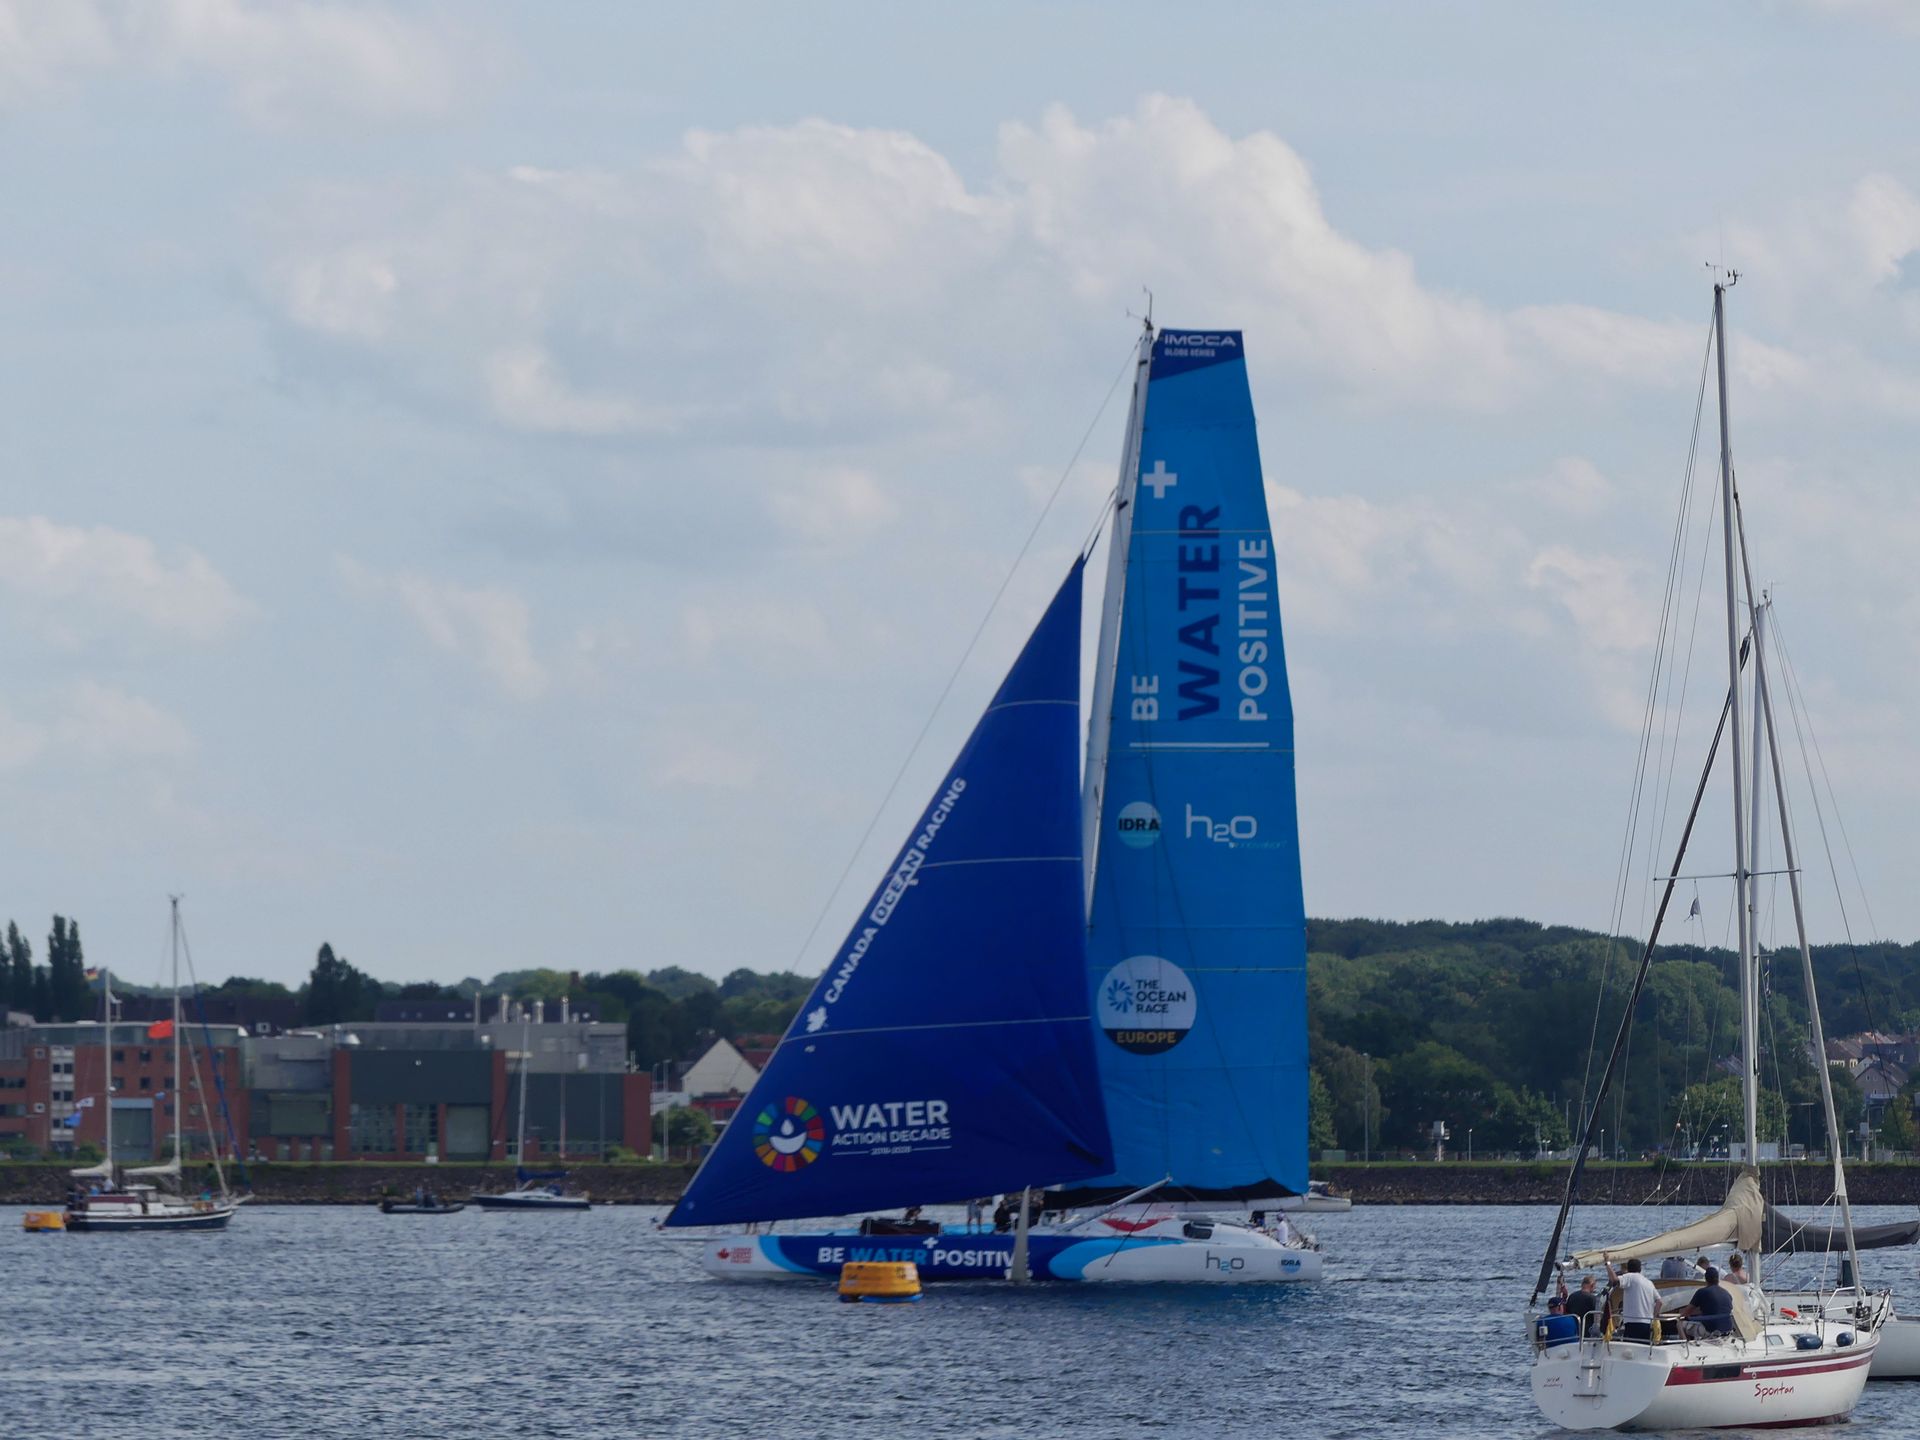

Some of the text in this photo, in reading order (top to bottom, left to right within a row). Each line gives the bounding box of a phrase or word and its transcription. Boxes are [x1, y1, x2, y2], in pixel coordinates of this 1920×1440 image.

[1164, 334, 1237, 347] IMOCA
[1178, 505, 1220, 721] WATER
[1238, 539, 1268, 721] POSITIVE
[1131, 674, 1159, 721] BE
[1118, 817, 1161, 831] IDRA
[824, 777, 967, 1004] CANADA OCEAN RACING
[1136, 979, 1159, 989] THE
[1136, 991, 1187, 1002] OCEAN
[1136, 1003, 1169, 1013] RACE
[1117, 1031, 1177, 1043] EUROPE
[830, 1099, 949, 1131] WATER
[832, 1127, 952, 1146] ACTION DECADE
[818, 1247, 1030, 1267] BE WATER POSITIV
[1754, 1380, 1795, 1404] Spontan
